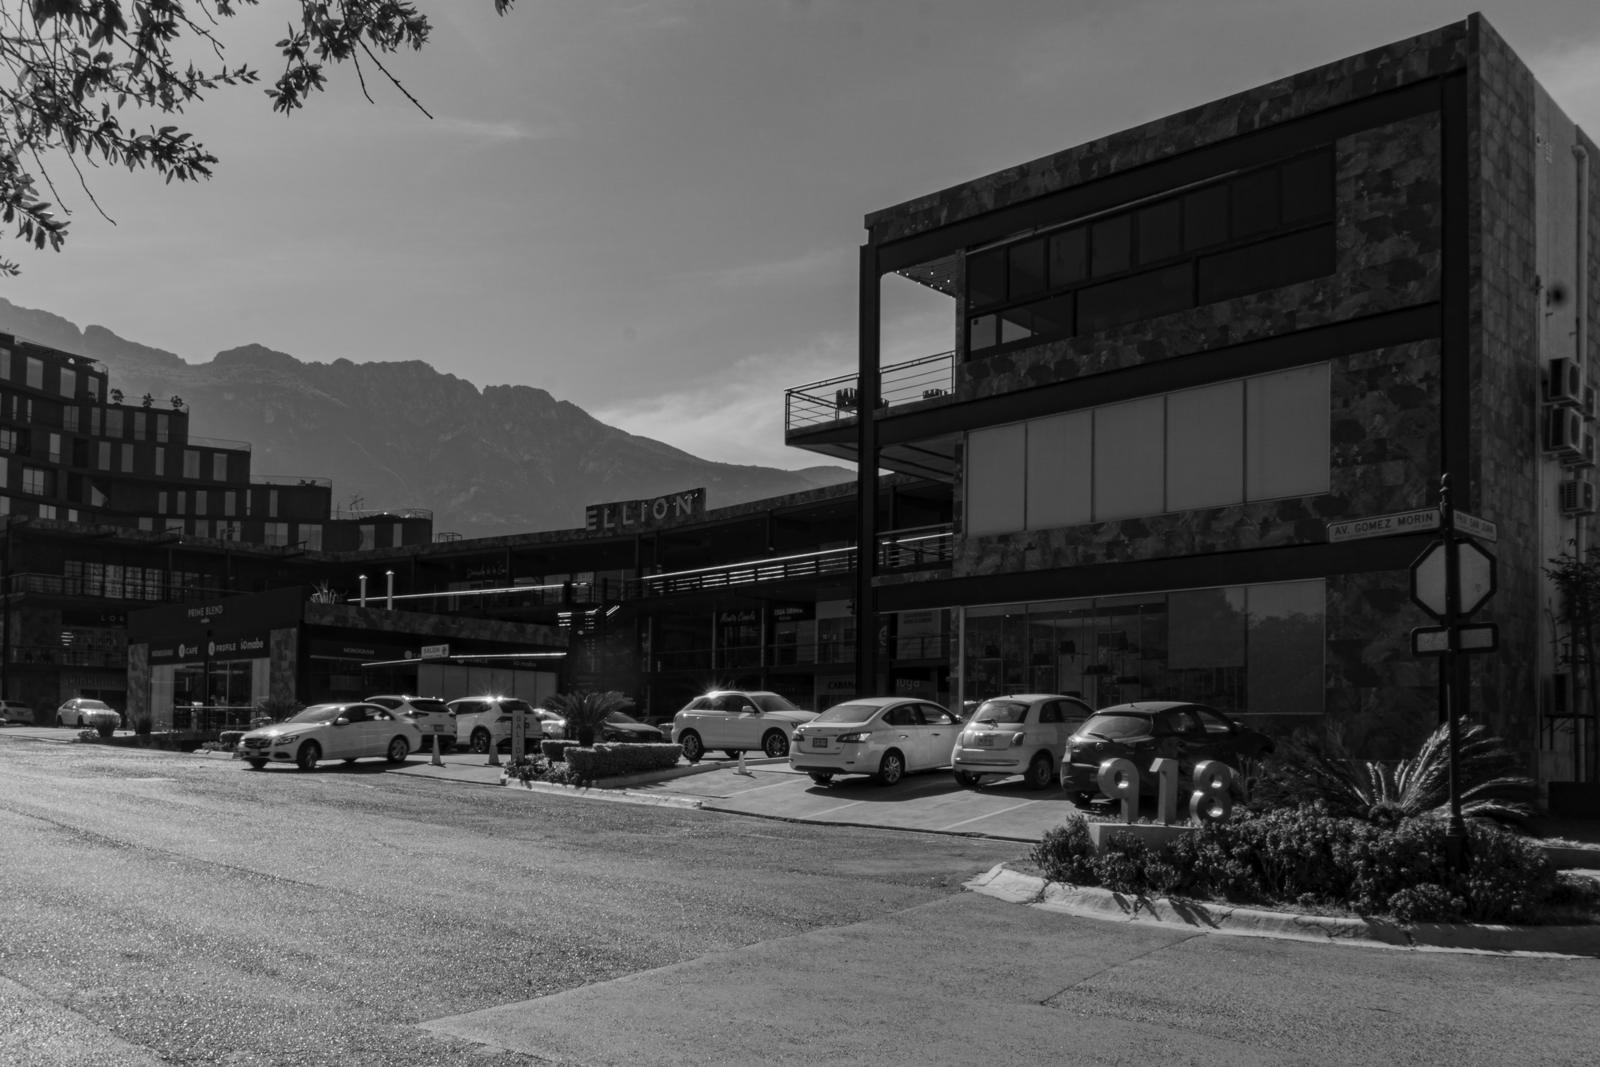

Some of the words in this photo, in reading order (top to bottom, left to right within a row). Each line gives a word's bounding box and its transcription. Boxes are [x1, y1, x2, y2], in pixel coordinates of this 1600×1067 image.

[585, 493, 693, 531] ELLION
[1334, 526, 1350, 537] AV.
[1354, 520, 1392, 533] GOMEZ
[1397, 513, 1434, 527] MORIN
[1097, 757, 1232, 826] 918
